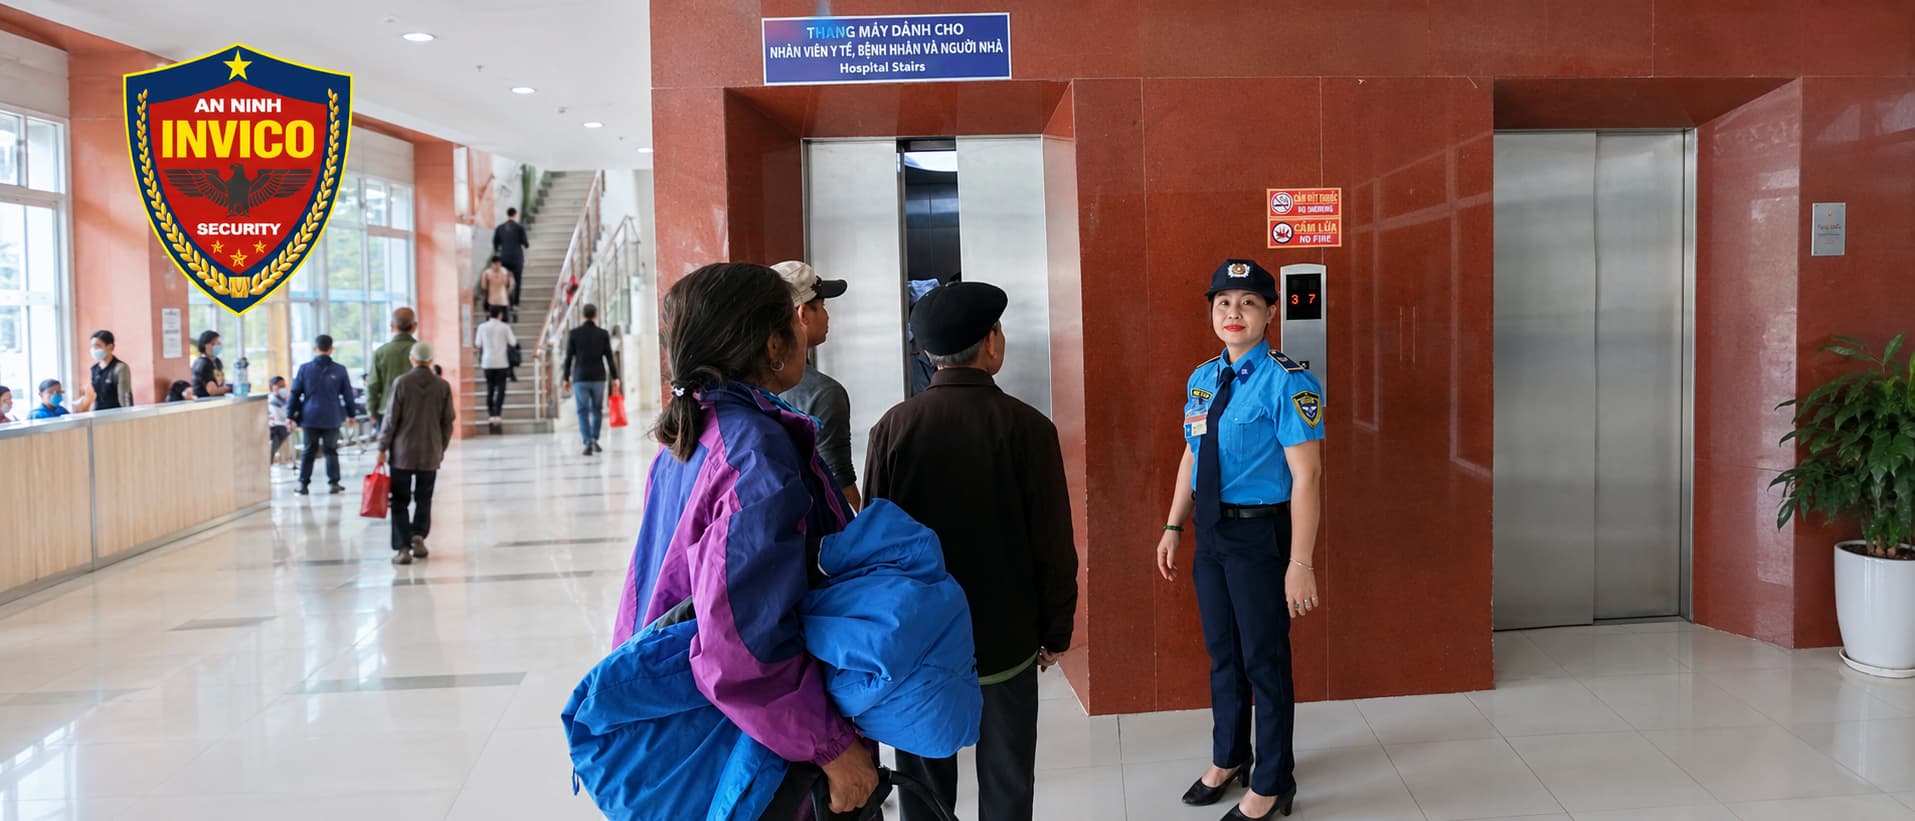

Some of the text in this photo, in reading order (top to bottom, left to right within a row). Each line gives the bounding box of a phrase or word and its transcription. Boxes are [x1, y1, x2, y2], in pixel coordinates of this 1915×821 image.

[806, 25, 856, 39] THANG
[934, 23, 964, 36] CHO
[829, 45, 838, 57] Y
[839, 60, 926, 76] Hospital Stairs
[1299, 234, 1332, 243] NO FIRE
[1291, 293, 1316, 305] 3 7
